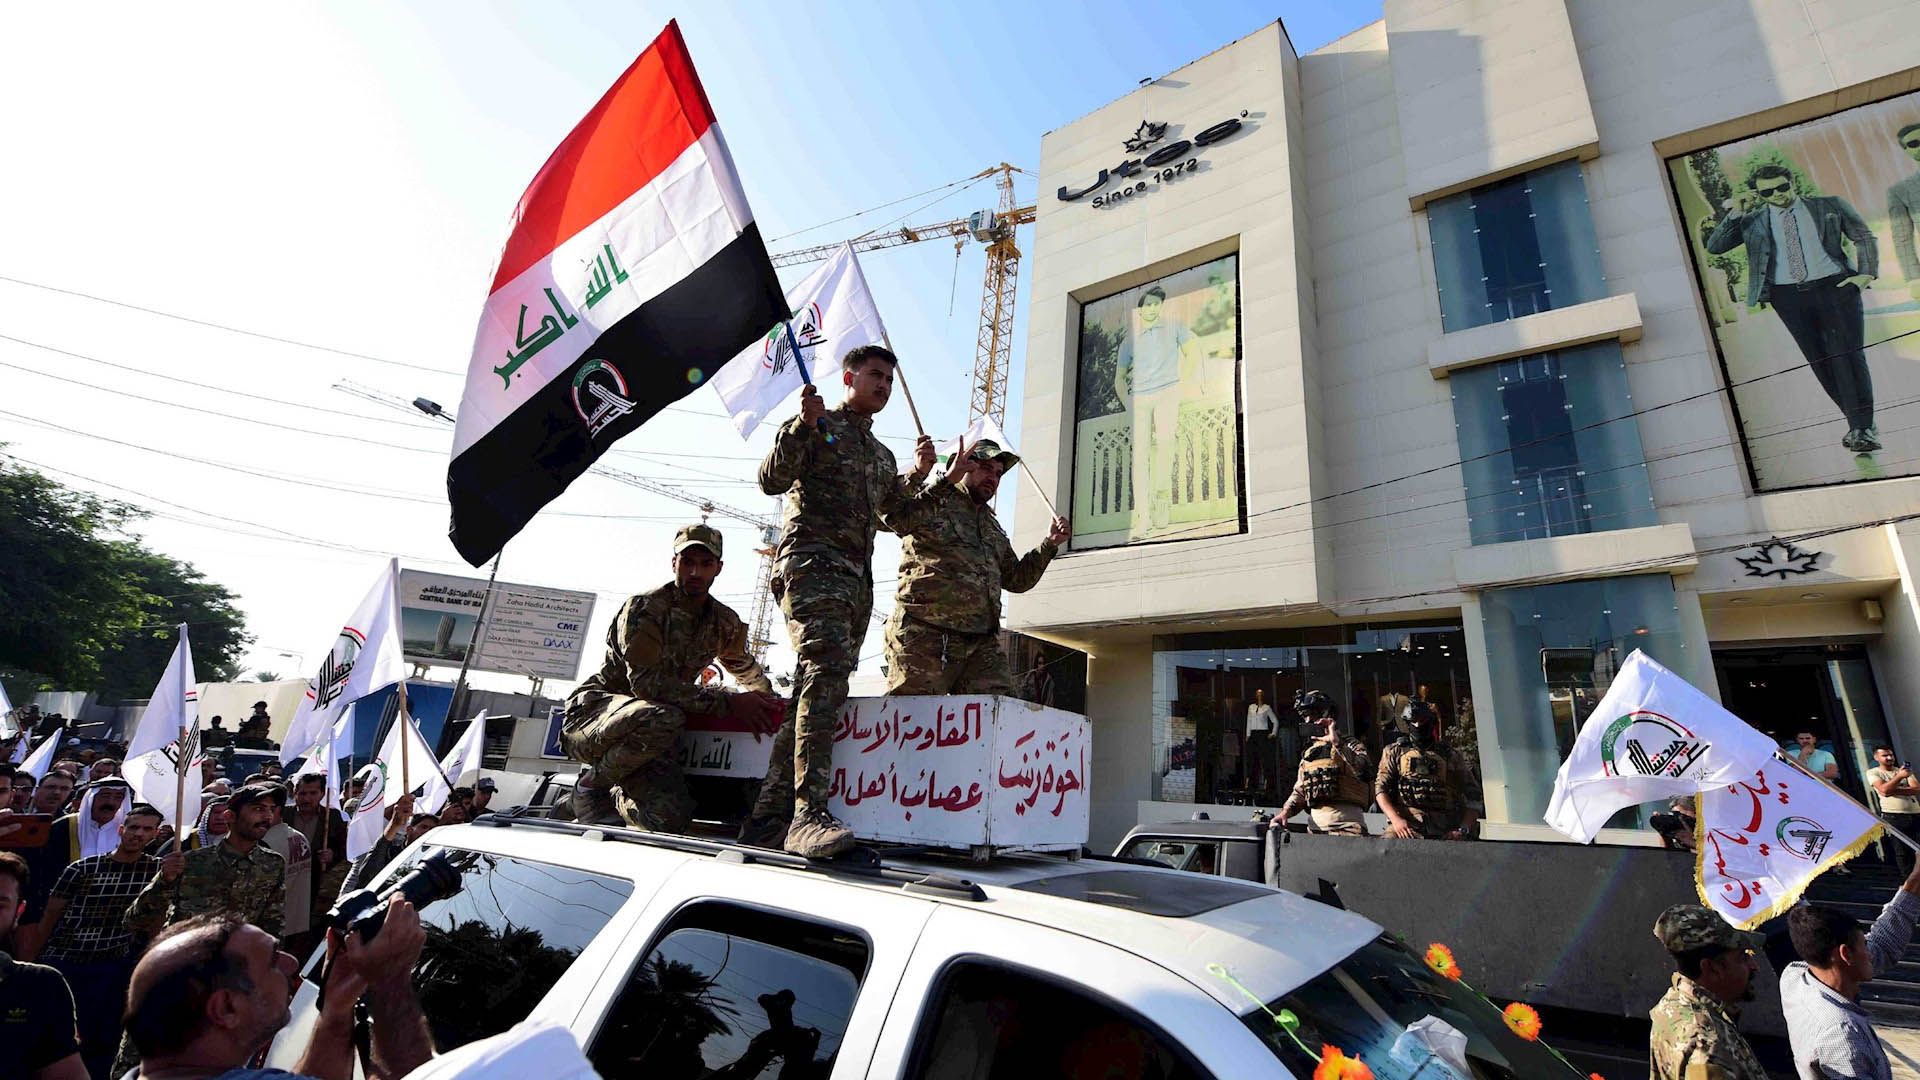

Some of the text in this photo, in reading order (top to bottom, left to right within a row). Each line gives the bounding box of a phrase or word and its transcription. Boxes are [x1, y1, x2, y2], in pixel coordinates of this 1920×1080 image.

[1092, 158, 1197, 209] Since 1972
[419, 594, 445, 603] CENTRAL
[524, 601, 544, 609] Hadid
[545, 604, 579, 613] Architects
[557, 622, 579, 631] CME
[543, 637, 574, 649] DAAX
[899, 702, 981, 751] المقاومة
[900, 768, 983, 822] عصائب
